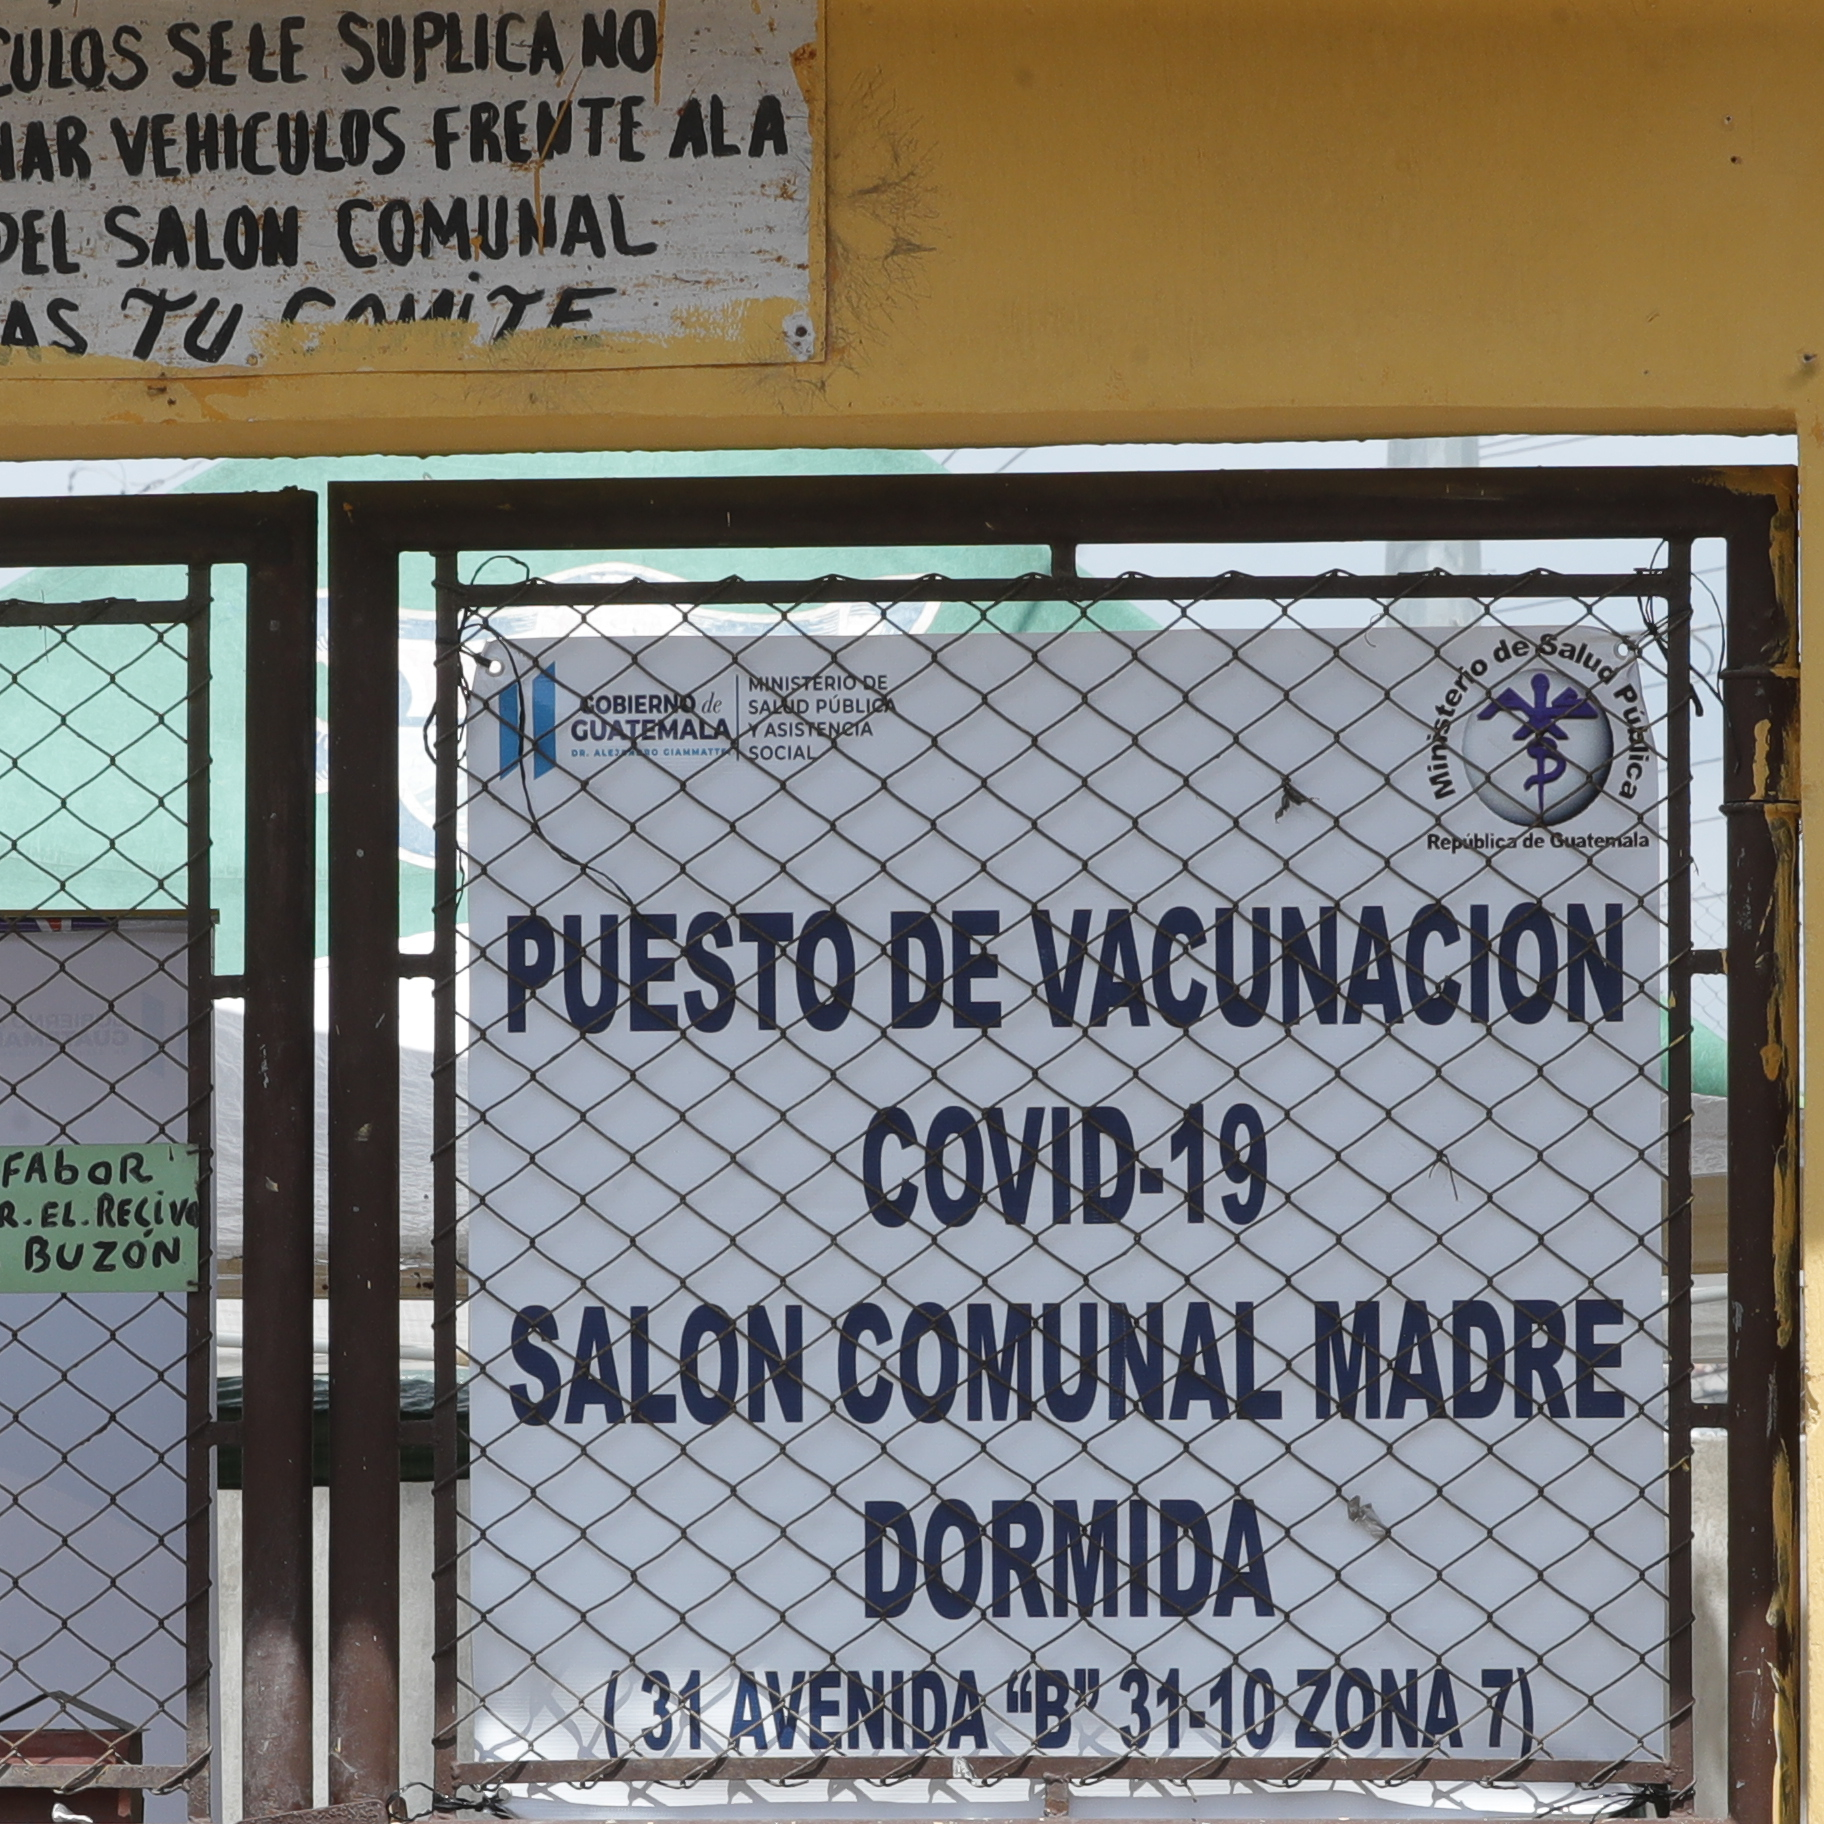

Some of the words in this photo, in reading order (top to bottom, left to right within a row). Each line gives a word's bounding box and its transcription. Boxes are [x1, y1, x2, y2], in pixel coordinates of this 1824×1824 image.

[338, 10, 564, 84] SUPLICA
[582, 9, 657, 73] NO
[110, 106, 406, 177] VEHICULOS
[432, 96, 645, 170] FRENTE
[104, 205, 298, 271] SALON
[337, 194, 658, 268] COMUNAL
[122, 288, 243, 362] TU
[580, 693, 696, 715] GOBIERNO
[701, 692, 723, 714] de
[748, 676, 856, 691] MINISTERIO
[864, 675, 887, 690] DE
[748, 699, 809, 714] SALUD
[816, 694, 896, 713] PÚBLICA
[1427, 658, 1488, 799] Ministerio
[1493, 640, 1530, 663] de
[1537, 633, 1619, 684] Salud
[1613, 683, 1650, 800] Pública
[571, 719, 732, 741] GUATEMALA
[571, 749, 589, 757] DR.
[748, 745, 817, 760] SOCIAL
[764, 722, 873, 738] ASISTENCIA
[1427, 833, 1517, 854] República
[1522, 833, 1544, 848] de
[1550, 832, 1650, 848] Guatemala
[507, 911, 855, 1033] PUESTO
[890, 909, 1002, 1030] DE
[1033, 903, 1624, 1028] VACUNACION
[863, 1102, 1268, 1227] COVID-19
[510, 1303, 804, 1426] SALON
[837, 1300, 1282, 1424] COMUNAL
[1314, 1298, 1626, 1420] MADRE
[864, 1499, 1274, 1619] DORMIDA
[728, 1670, 988, 1751] AVENIDA
[1120, 1667, 1273, 1750] 31-10
[1297, 1667, 1463, 1749] ZONA
